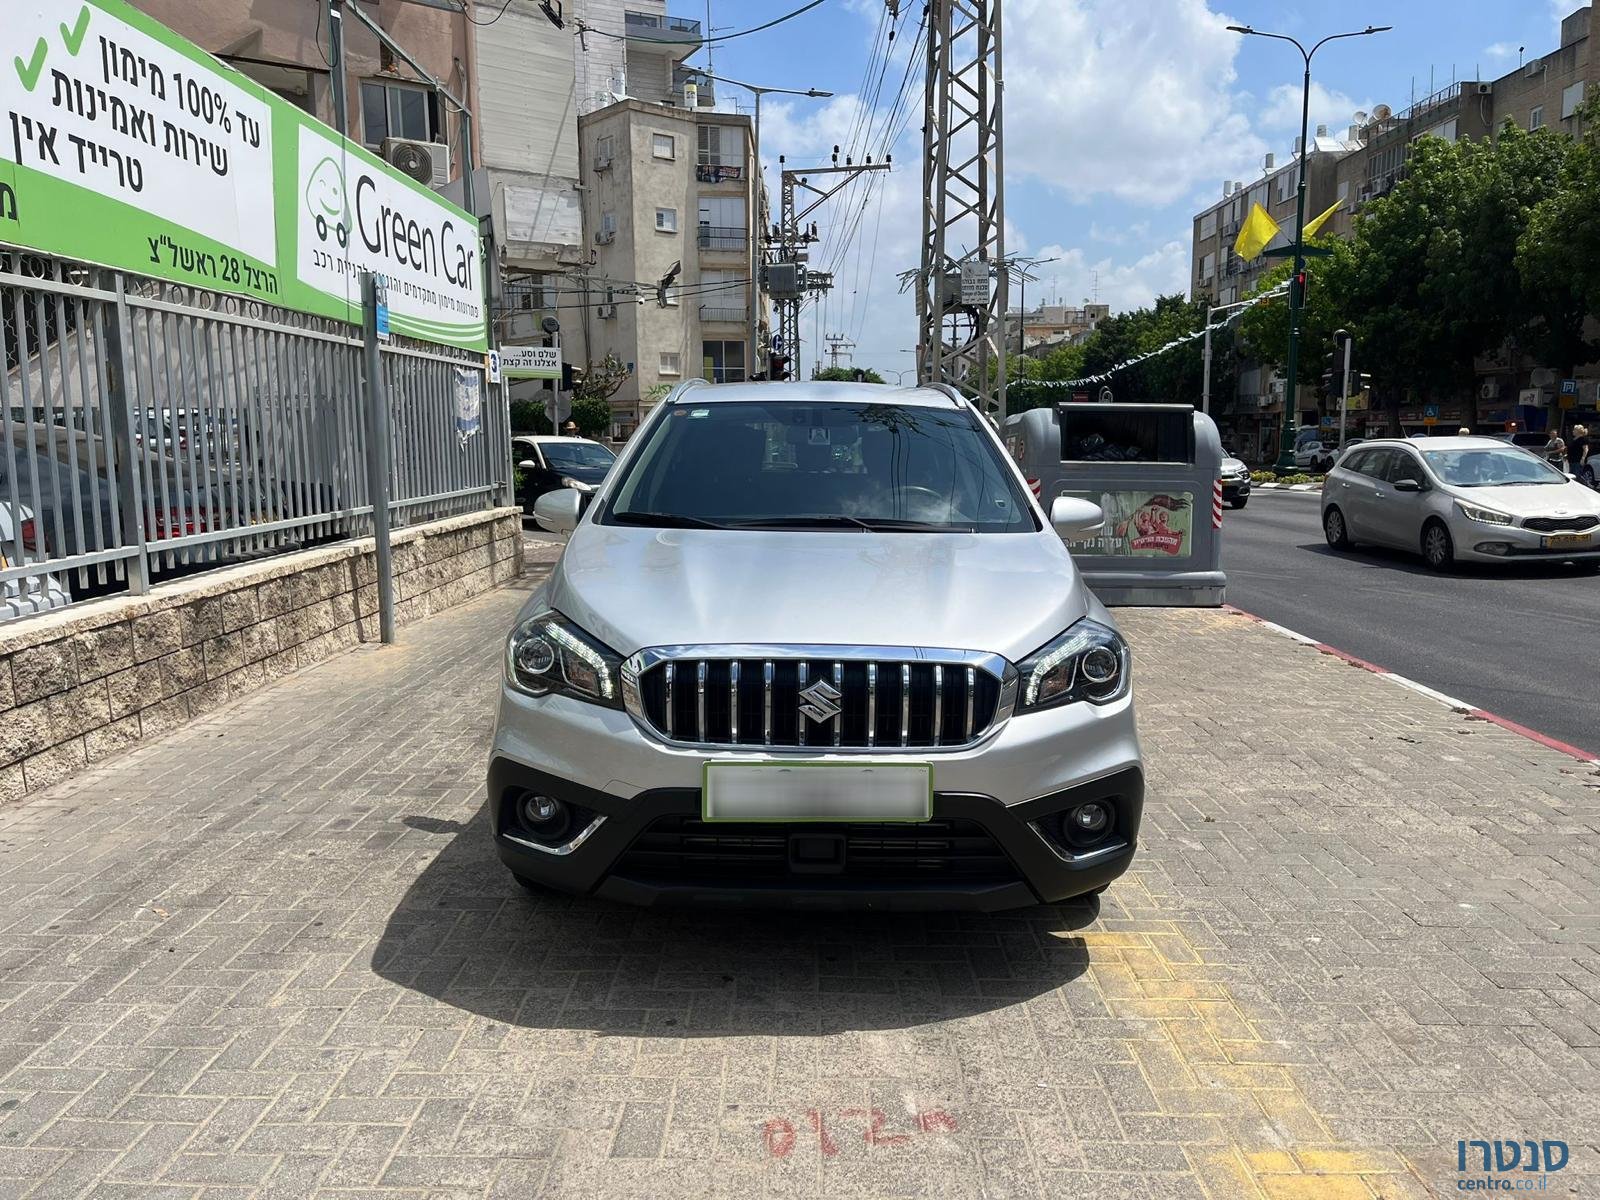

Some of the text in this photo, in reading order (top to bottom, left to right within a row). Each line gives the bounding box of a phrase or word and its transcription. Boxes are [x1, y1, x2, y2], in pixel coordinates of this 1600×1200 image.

[99, 35, 260, 149] עד 100% מימון
[51, 68, 228, 177] שירות ואמינות
[8, 111, 143, 193] טרייד אין
[356, 174, 474, 291] Green Car
[220, 254, 240, 284] 28
[313, 249, 334, 271] רכב
[243, 259, 278, 294] הרצל
[404, 281, 437, 305] מתקדמים
[438, 294, 455, 311] מימון
[502, 359, 521, 368] קצת
[534, 359, 557, 367] אצלנו
[538, 350, 557, 358] שלם
